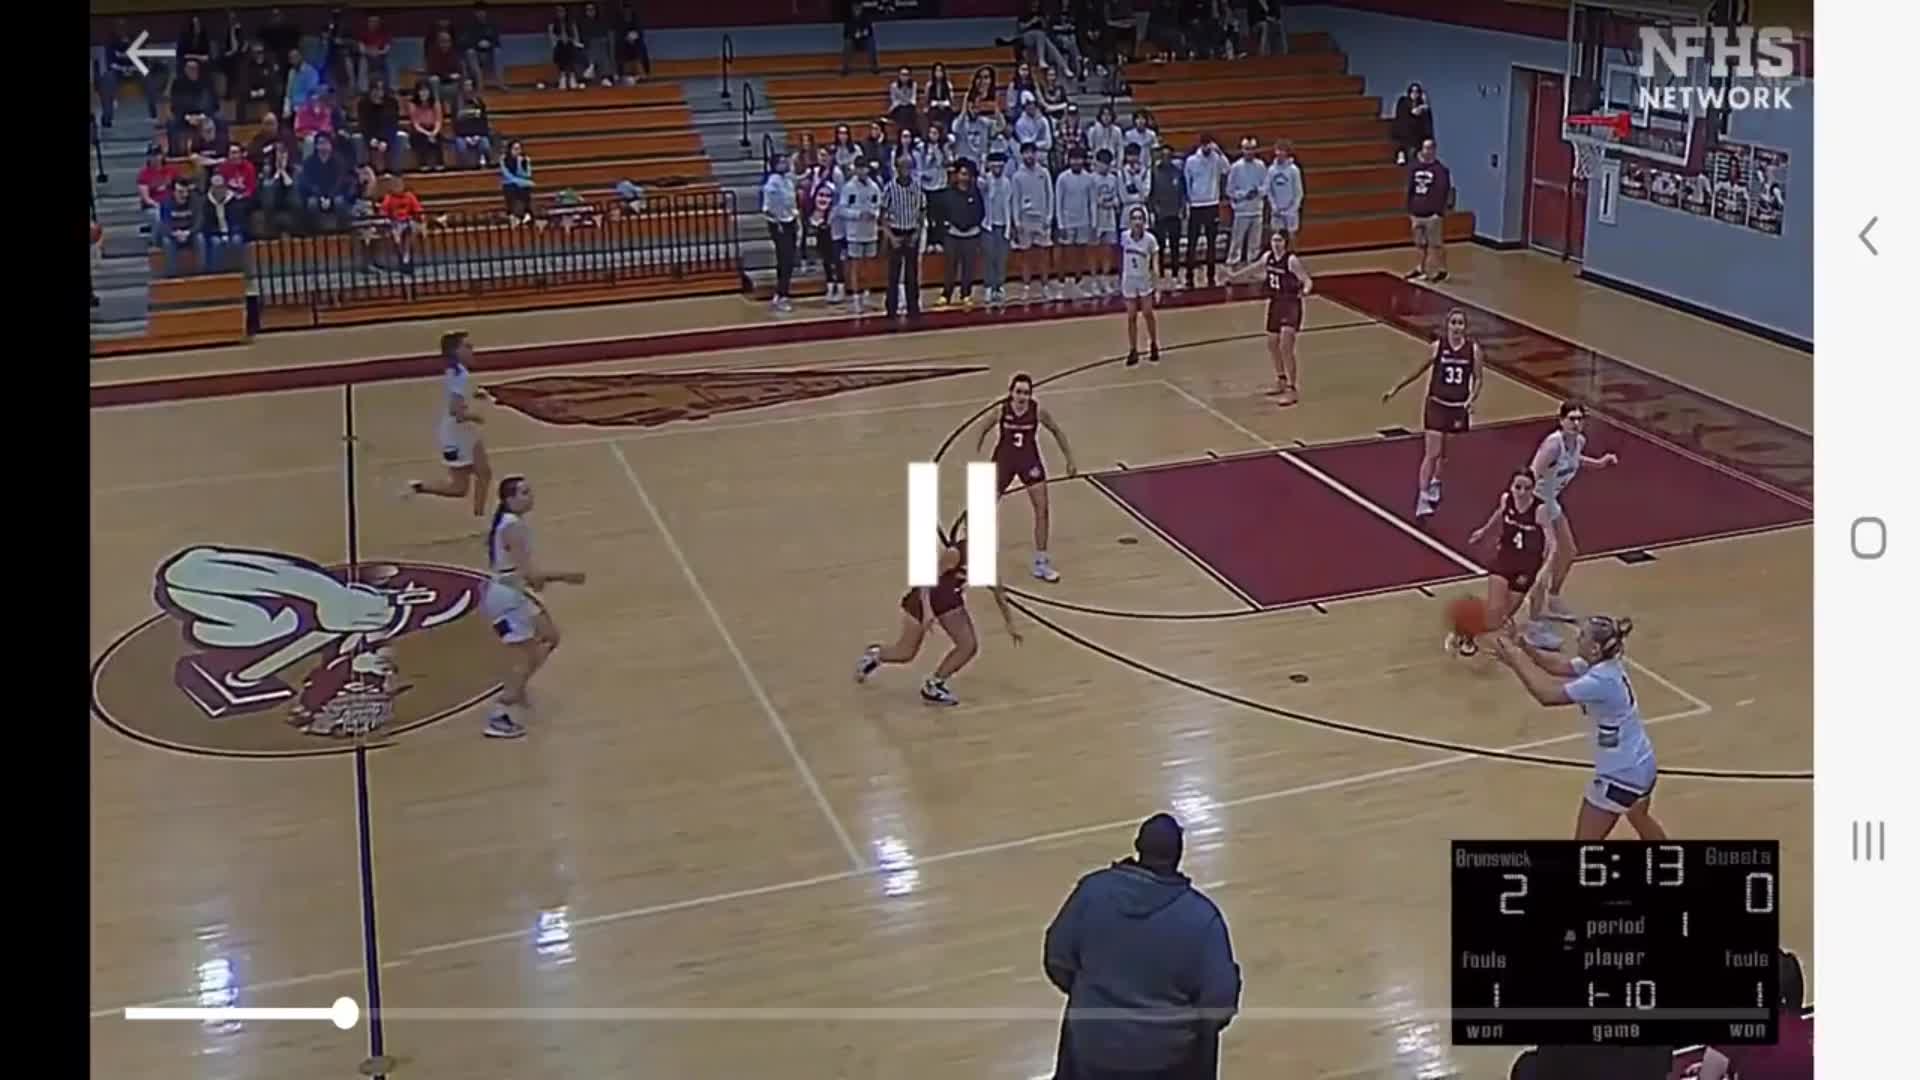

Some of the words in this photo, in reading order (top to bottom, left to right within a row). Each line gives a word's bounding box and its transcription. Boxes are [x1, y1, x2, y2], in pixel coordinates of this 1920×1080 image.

[1445, 366, 1464, 384] 33
[1013, 432, 1024, 448] 3
[1513, 531, 1524, 550] 4
